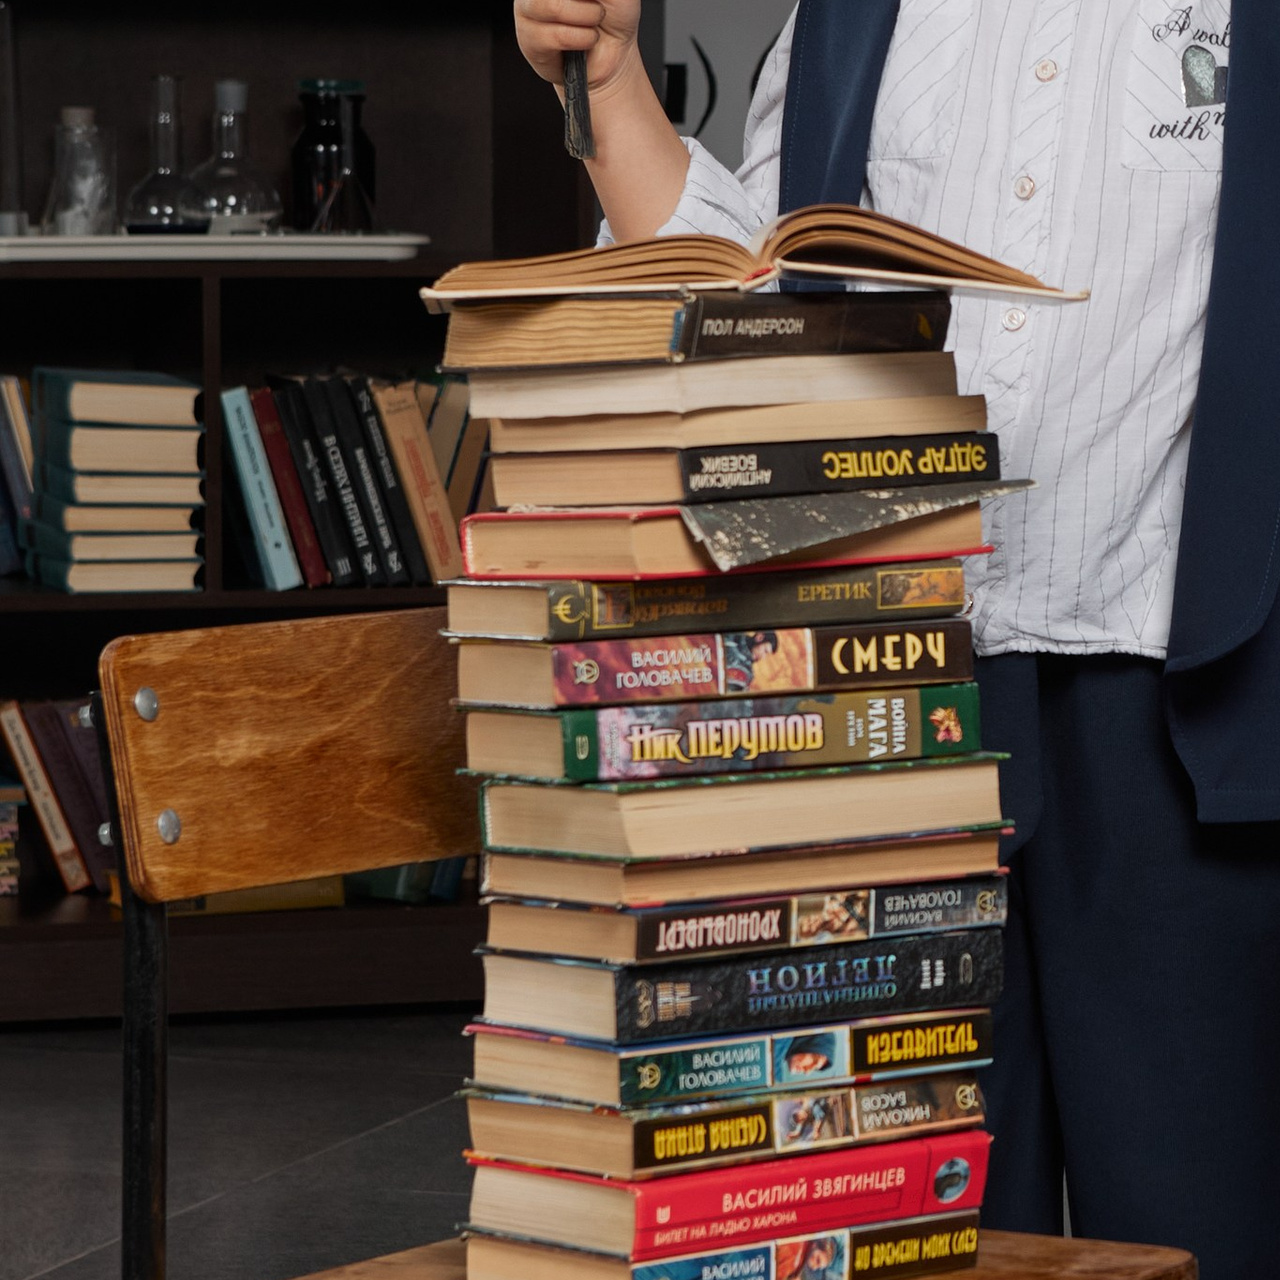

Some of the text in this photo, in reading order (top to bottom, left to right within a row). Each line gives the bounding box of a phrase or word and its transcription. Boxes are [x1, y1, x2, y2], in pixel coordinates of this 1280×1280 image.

[1192, 21, 1231, 49] wal
[1149, 111, 1210, 141] with
[702, 318, 805, 337] ПОЛ АНДЕРСОН
[700, 454, 757, 471] БОЕВИК
[821, 442, 988, 480] ЭДГАР УОЛЛЕС
[689, 469, 771, 491] АНГЛИЙСКИЙ
[797, 582, 872, 603] ЕРЕТИК
[631, 645, 712, 668] ВАСИЛИЙ
[831, 633, 945, 674] СМЕРЧ
[616, 668, 712, 689] ГОЛОВАЧЕВ
[867, 698, 888, 759] МАГА
[891, 697, 908, 755] ВОЙНА
[884, 889, 962, 913] ГОЛОВАЧЕВ
[656, 908, 781, 952] ХРОНОВЫВЕРТ
[884, 909, 943, 929] ВАСИЛИЙ
[748, 954, 897, 995] ЛЕГИОН
[748, 981, 897, 1015] ОДИННАДЦАТЫЙ
[692, 1043, 760, 1070] ВАСИЛИЙ
[866, 1023, 979, 1065] ИЗБАВИТЕЛЬ
[678, 1065, 761, 1090] ГОЛОВАЧЕВ
[860, 1091, 907, 1111] БАСОВ
[862, 1104, 930, 1130] НИКОЛАЙ
[653, 1113, 767, 1160] СЛЕПАЯ АТАКА
[722, 1167, 906, 1213] ВАСИЛИЙ ЗВЯГИНЦЕВ
[654, 1210, 798, 1247] БИЛЕТ НА ЛАДЬЮ ХАРОНА
